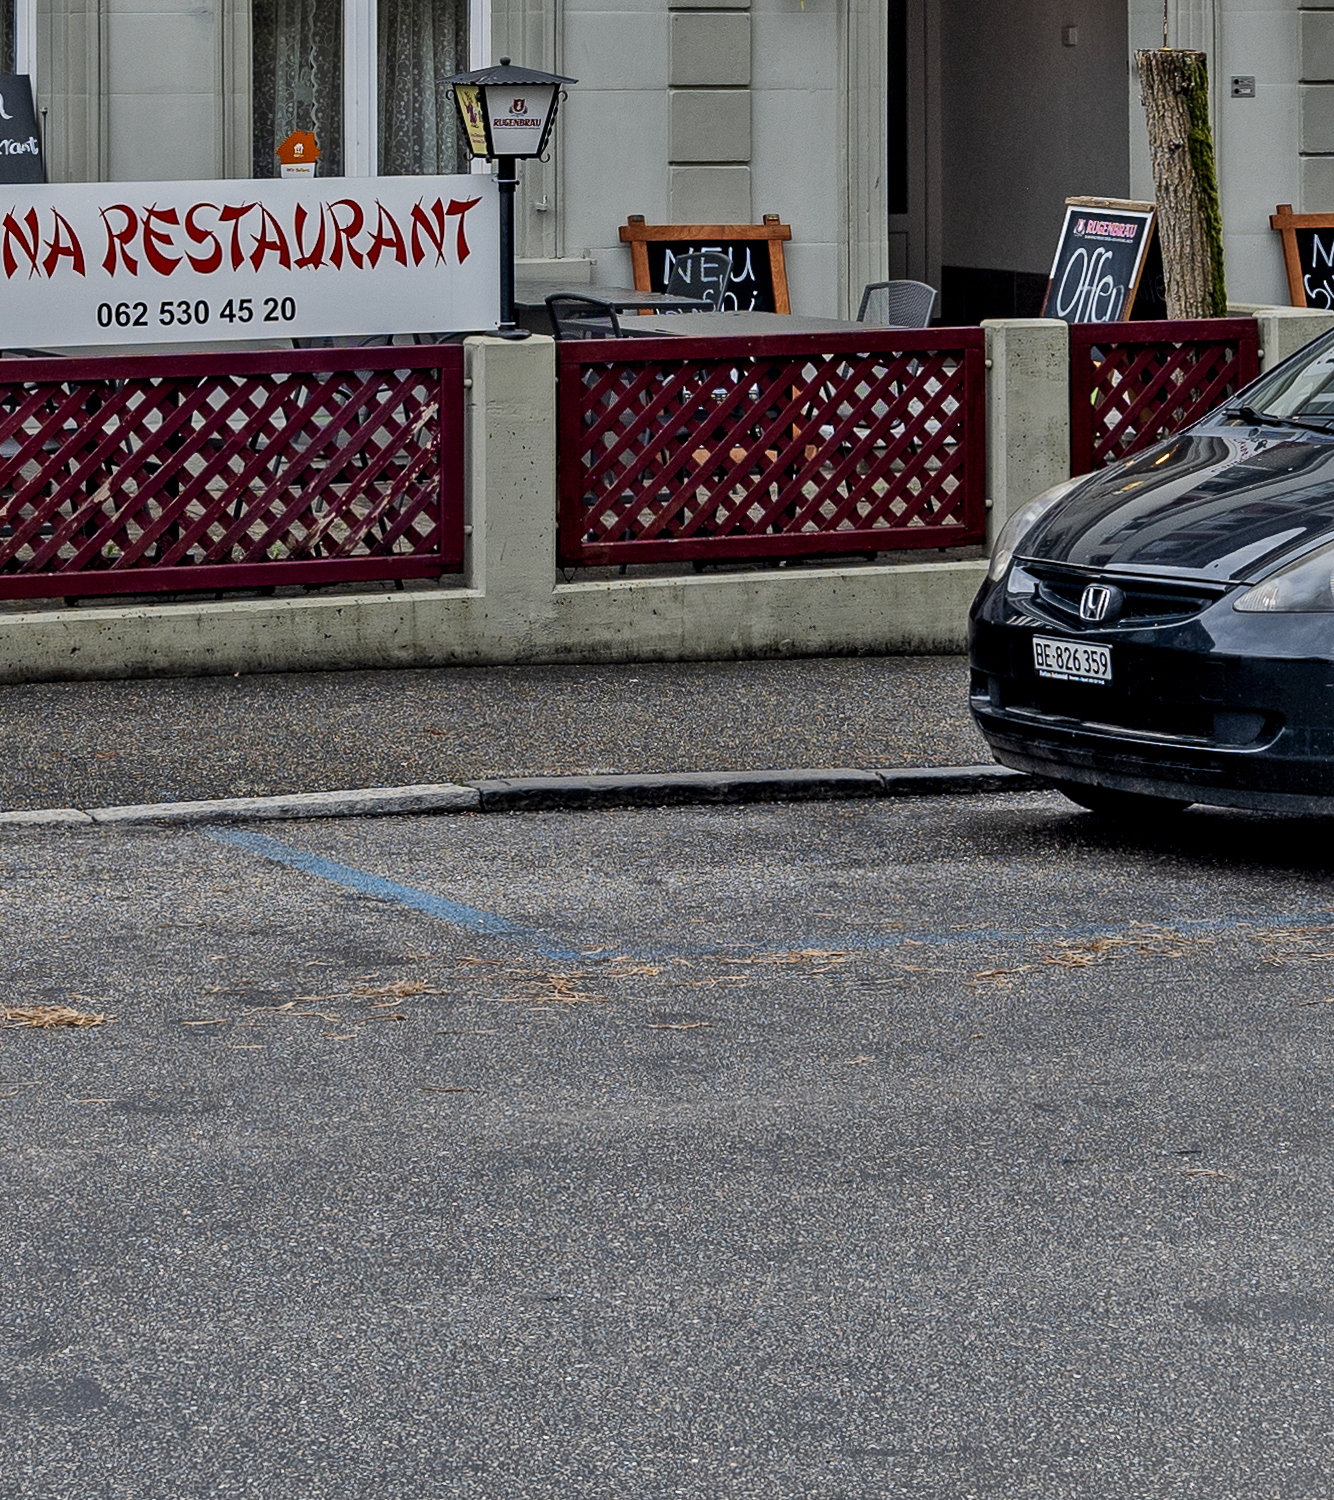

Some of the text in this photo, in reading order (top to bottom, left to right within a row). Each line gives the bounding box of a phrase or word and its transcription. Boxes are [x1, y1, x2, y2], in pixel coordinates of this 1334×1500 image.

[98, 195, 483, 278] RESTAURANT
[663, 246, 756, 285] NEU
[97, 296, 297, 328] 062 530 45 20
[1056, 246, 1125, 323] Offen
